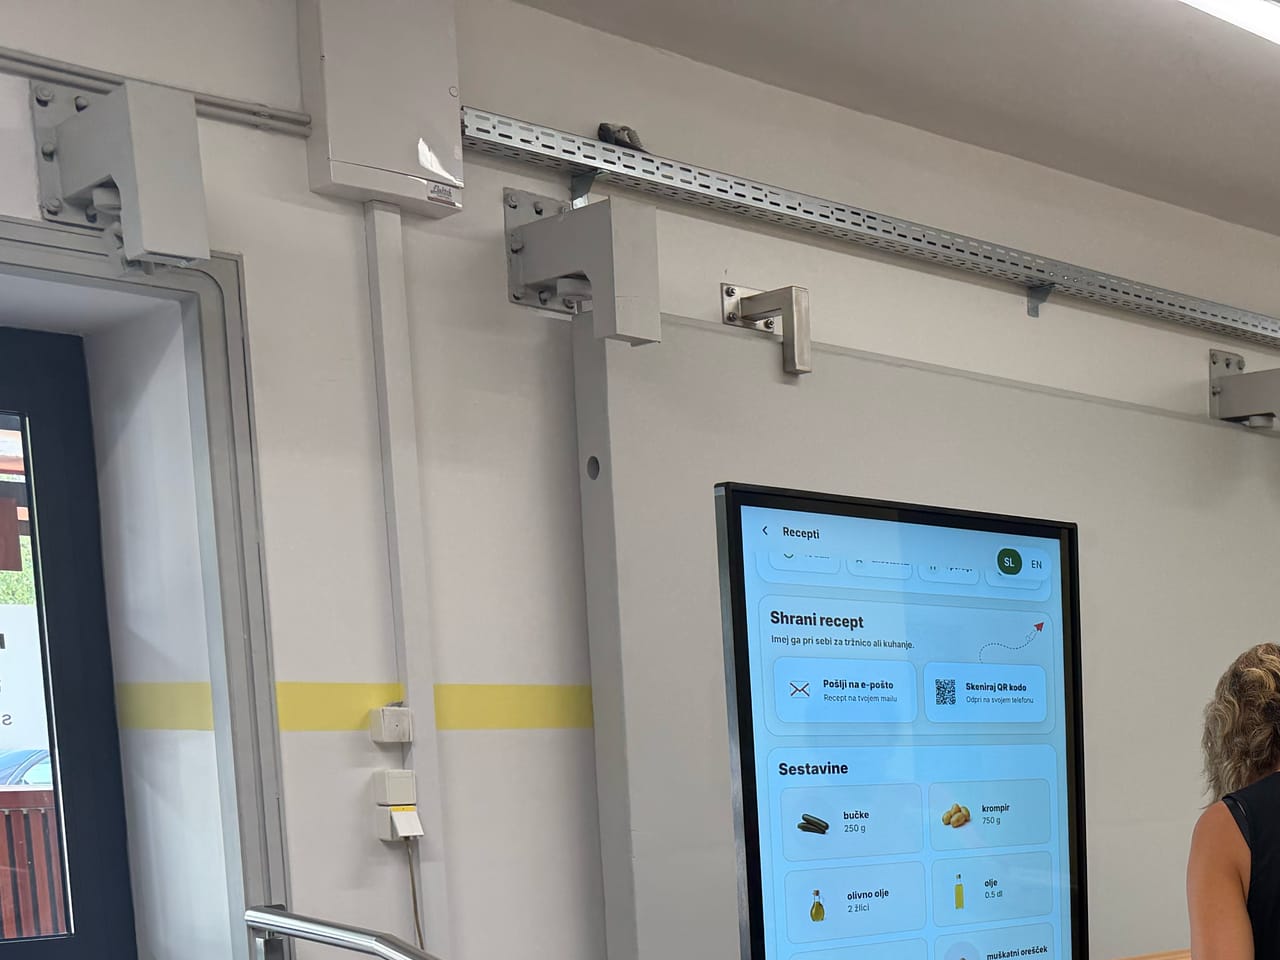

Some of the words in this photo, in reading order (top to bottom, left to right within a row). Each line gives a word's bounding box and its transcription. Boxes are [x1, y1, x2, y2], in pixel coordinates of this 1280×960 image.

[782, 526, 820, 541] Recepti
[1003, 557, 1015, 568] SL
[1031, 559, 1043, 570] EN
[770, 610, 817, 626] Shrani
[819, 616, 865, 631] recept
[771, 634, 790, 646] Imej
[790, 637, 801, 646] ga
[802, 635, 815, 646] pri
[815, 637, 833, 646] sebi
[844, 638, 872, 648] tržnico
[873, 639, 883, 648] ali
[883, 640, 915, 651] kuhanje.
[823, 679, 847, 690] Pošlji
[848, 681, 860, 689] na
[860, 680, 894, 691] e-pošto
[965, 682, 997, 693] Skeniraj
[997, 683, 1009, 691] QR
[1009, 683, 1027, 692] kodo
[823, 693, 847, 703] Recept
[857, 694, 880, 704] tvojem
[880, 694, 898, 703] mailu
[966, 696, 982, 705] Odpri
[991, 697, 1012, 705] svojem
[778, 761, 849, 776] Sestavine
[981, 803, 1010, 813] krompir
[843, 810, 870, 820] bučke
[982, 817, 995, 825] 750
[844, 824, 859, 833] 250
[860, 825, 866, 834] g
[984, 879, 998, 889] olje
[847, 890, 873, 901] olivno
[874, 888, 890, 900] olje
[996, 890, 1003, 898] dl
[854, 903, 870, 912] žlici
[986, 948, 1020, 960] muškatni
[1020, 945, 1048, 957] orešček
